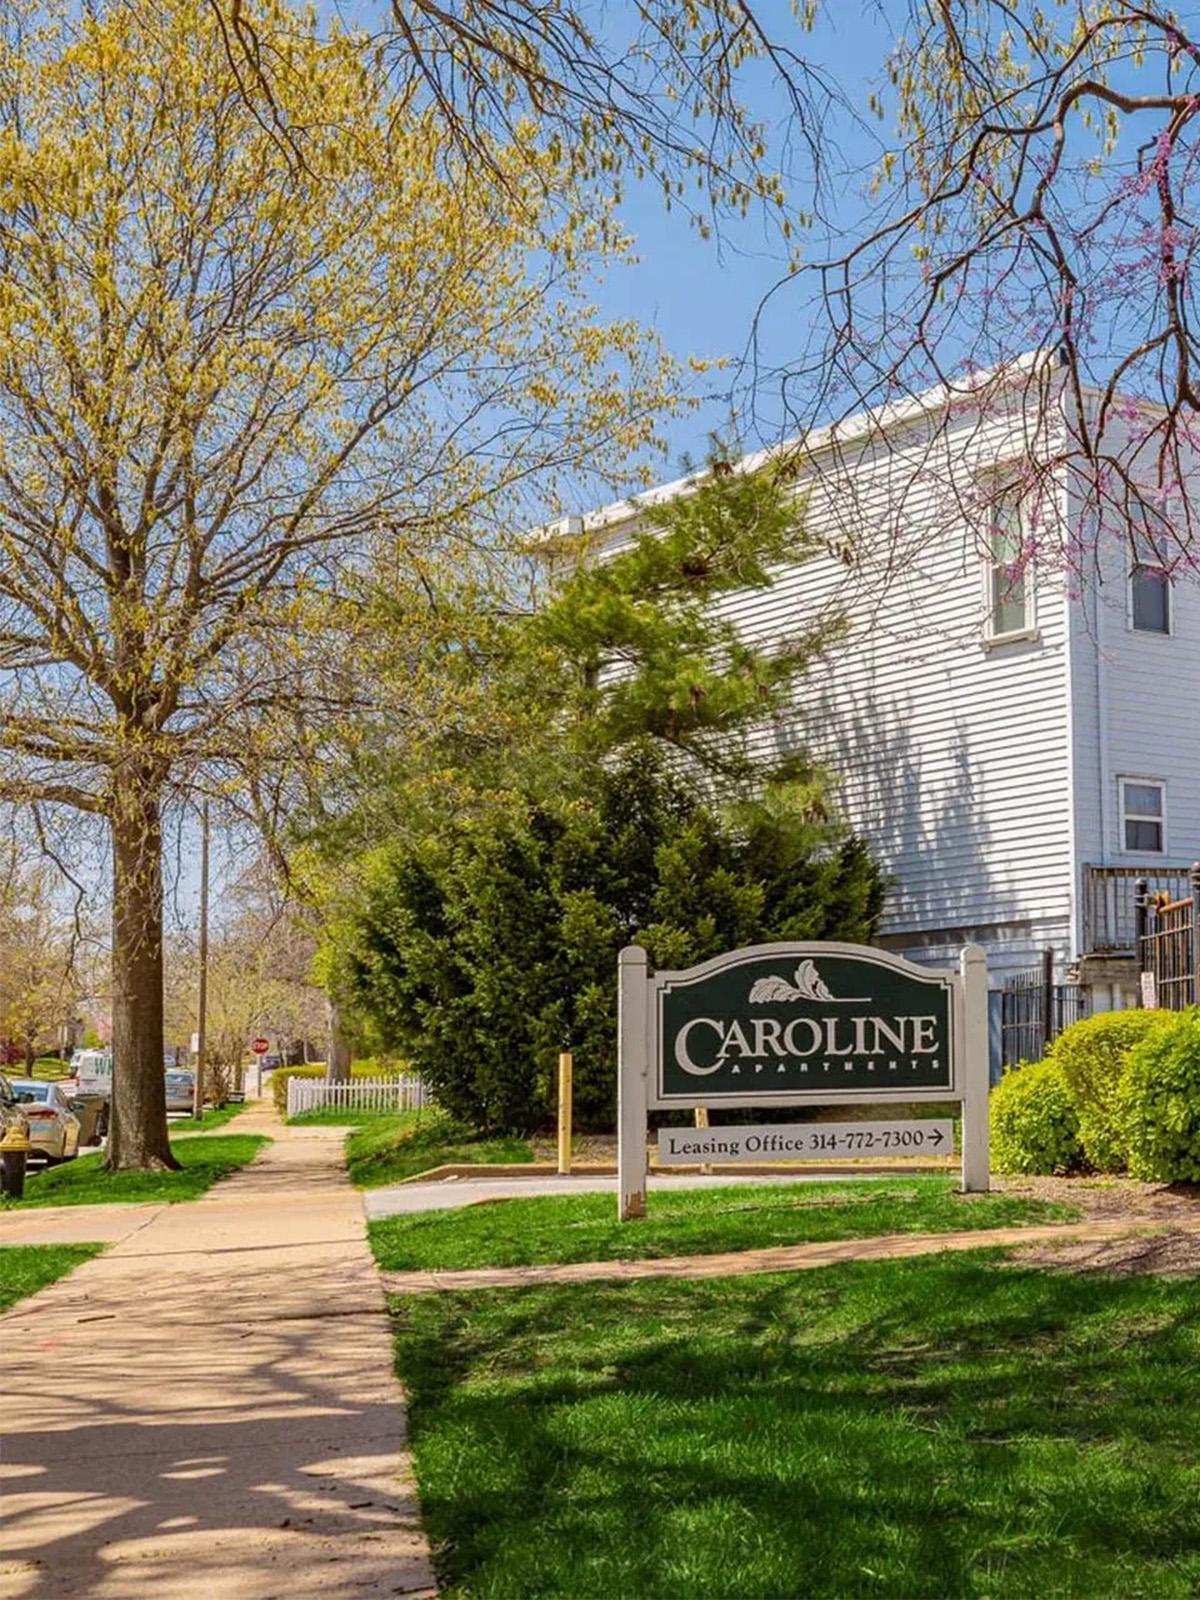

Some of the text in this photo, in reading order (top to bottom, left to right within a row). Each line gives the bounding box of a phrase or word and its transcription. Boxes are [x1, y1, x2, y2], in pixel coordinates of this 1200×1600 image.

[674, 1016, 939, 1075] CAROLINE
[731, 1060, 939, 1074] APARTMENTS
[669, 1130, 924, 1156] Leasing Office 314-772-7300
